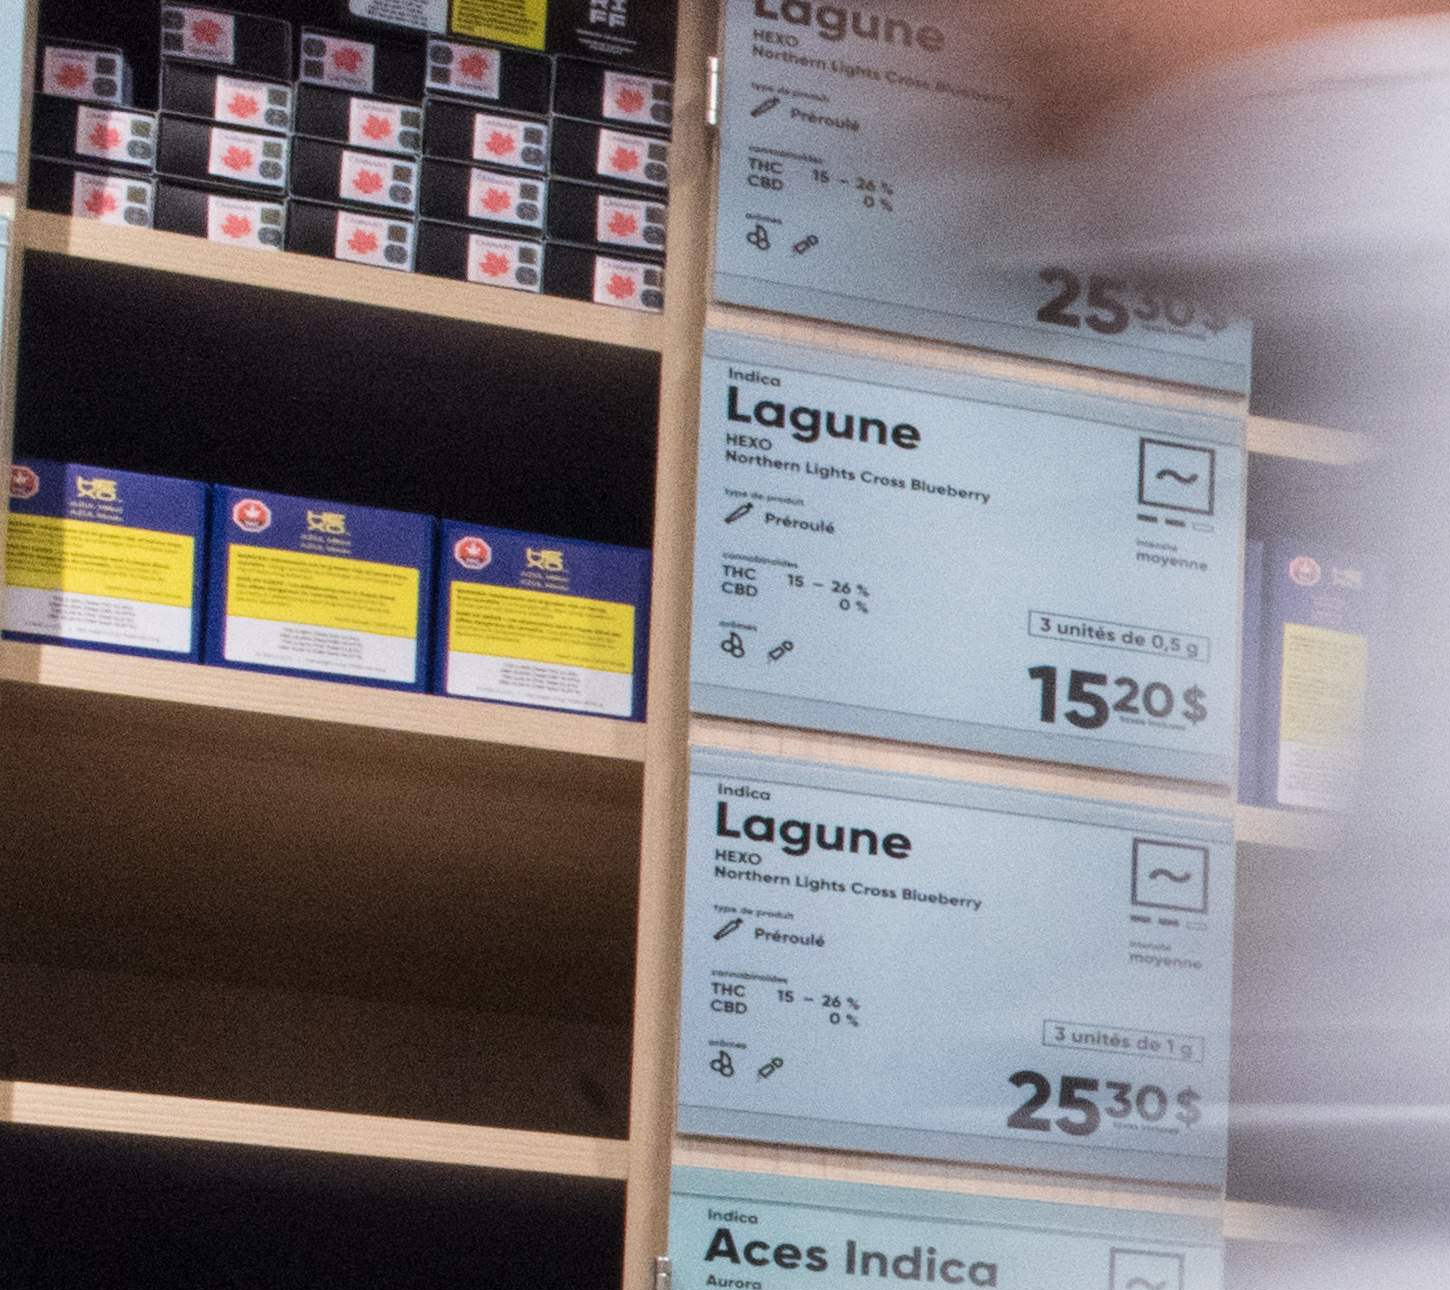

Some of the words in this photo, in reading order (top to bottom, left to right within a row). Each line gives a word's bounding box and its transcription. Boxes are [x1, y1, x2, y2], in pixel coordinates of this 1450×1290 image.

[728, 368, 781, 387] Indica
[727, 386, 921, 450] Lagune
[726, 434, 773, 450] HEXO
[725, 451, 801, 472] Northern
[806, 461, 855, 482] Lights
[860, 471, 906, 489] Cross
[911, 478, 991, 504] Blueberry
[765, 512, 835, 535] Préroulé
[721, 582, 758, 598] CBD
[722, 565, 757, 580] THC
[832, 581, 851, 595] 26
[1040, 617, 1051, 632] 3
[1057, 618, 1116, 642] unités
[1122, 629, 1146, 646] de
[1151, 634, 1181, 654] 0,5
[1186, 643, 1198, 658] g
[717, 784, 771, 801] Indica
[716, 802, 912, 859] Lagune
[715, 849, 762, 865] HEXO
[714, 867, 791, 886] Northern
[796, 876, 845, 895] Lights
[852, 883, 896, 900] Cross
[902, 888, 982, 911] Blueberry
[754, 927, 825, 948] Préroulé
[1054, 1028, 1066, 1042] 3
[1071, 1028, 1131, 1051] unités
[1137, 1036, 1161, 1052] de
[708, 1209, 758, 1225] Indica
[704, 1228, 828, 1272] Aces
[845, 1240, 998, 1287] Indica
[706, 1275, 762, 1290] Aurora
